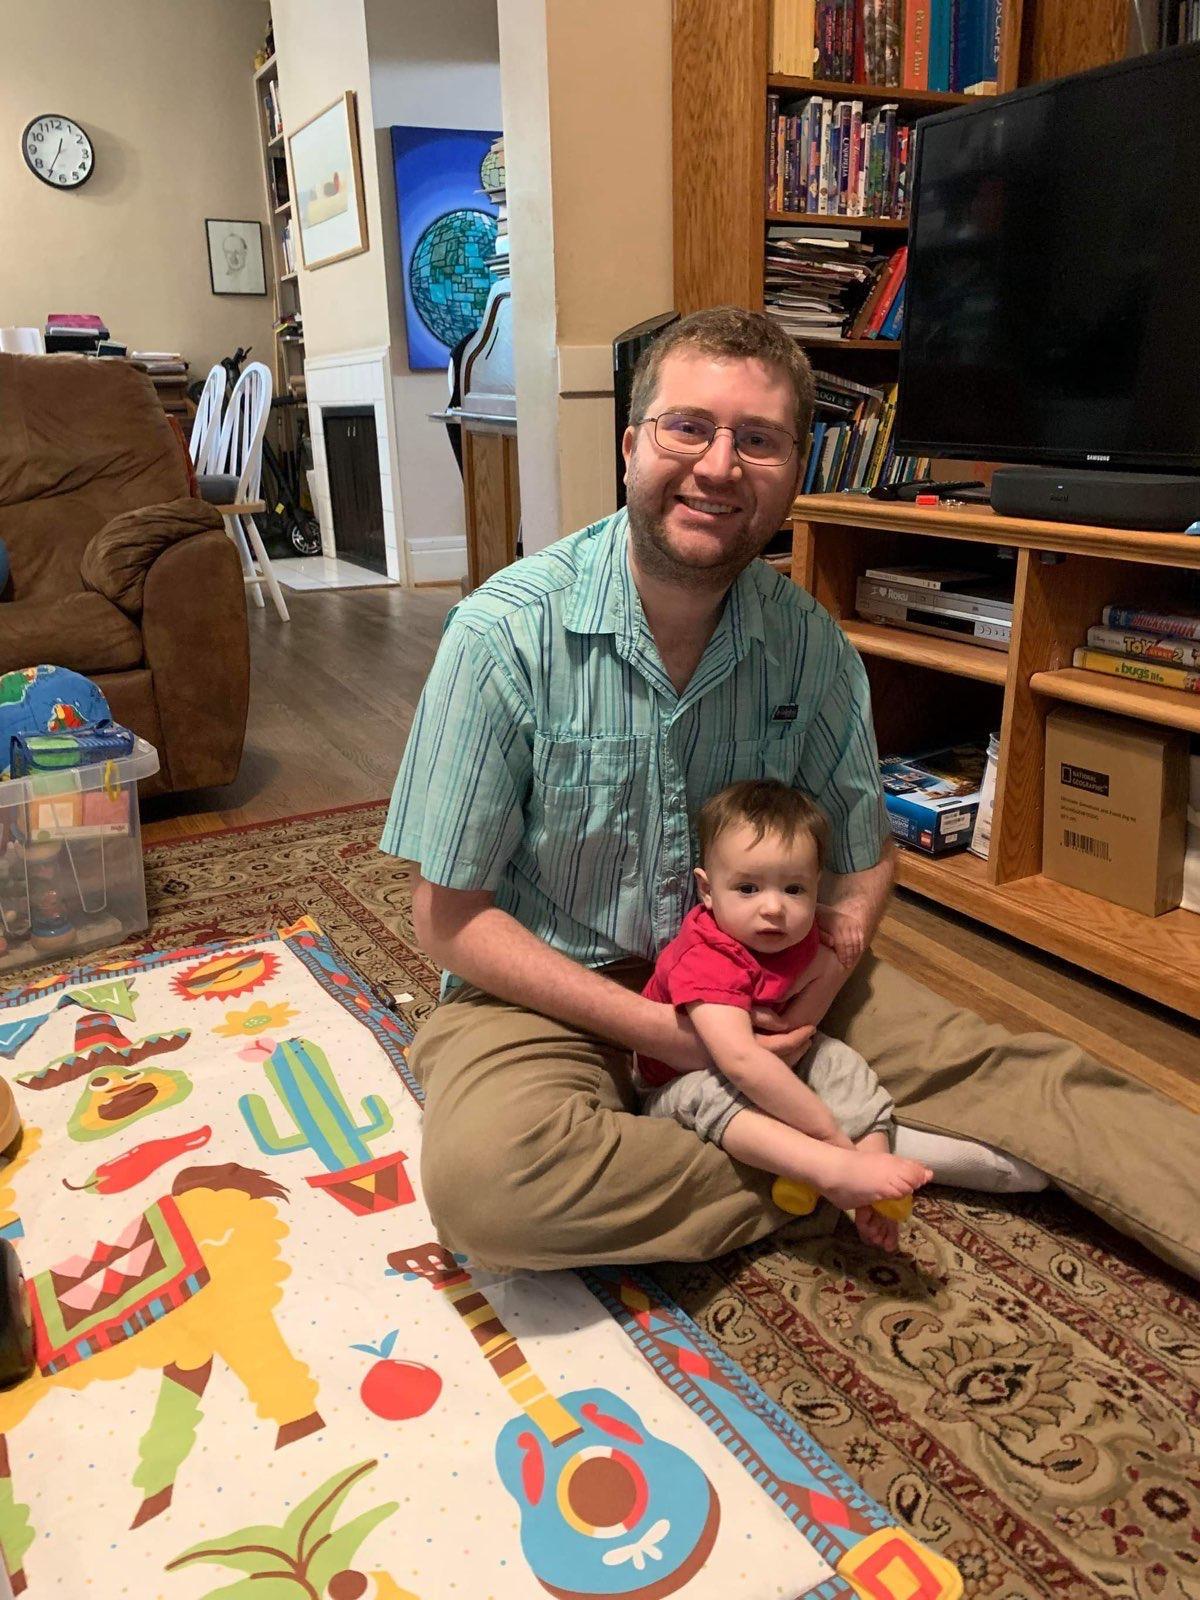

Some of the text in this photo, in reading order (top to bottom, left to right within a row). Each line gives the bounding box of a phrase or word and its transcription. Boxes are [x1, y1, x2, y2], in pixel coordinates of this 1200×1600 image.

[912, 49, 924, 76] Pan
[39, 122, 50, 133] 11
[49, 120, 62, 130] 12
[31, 132, 44, 142] 10
[76, 134, 83, 144] 2
[29, 145, 37, 155] 9
[81, 149, 89, 159] 3
[34, 159, 44, 169] 8
[78, 162, 86, 171] 4
[59, 174, 67, 183] 6
[72, 171, 80, 180] 5
[1173, 647, 1184, 663] 2
[1072, 771, 1097, 783] NATIONAL
